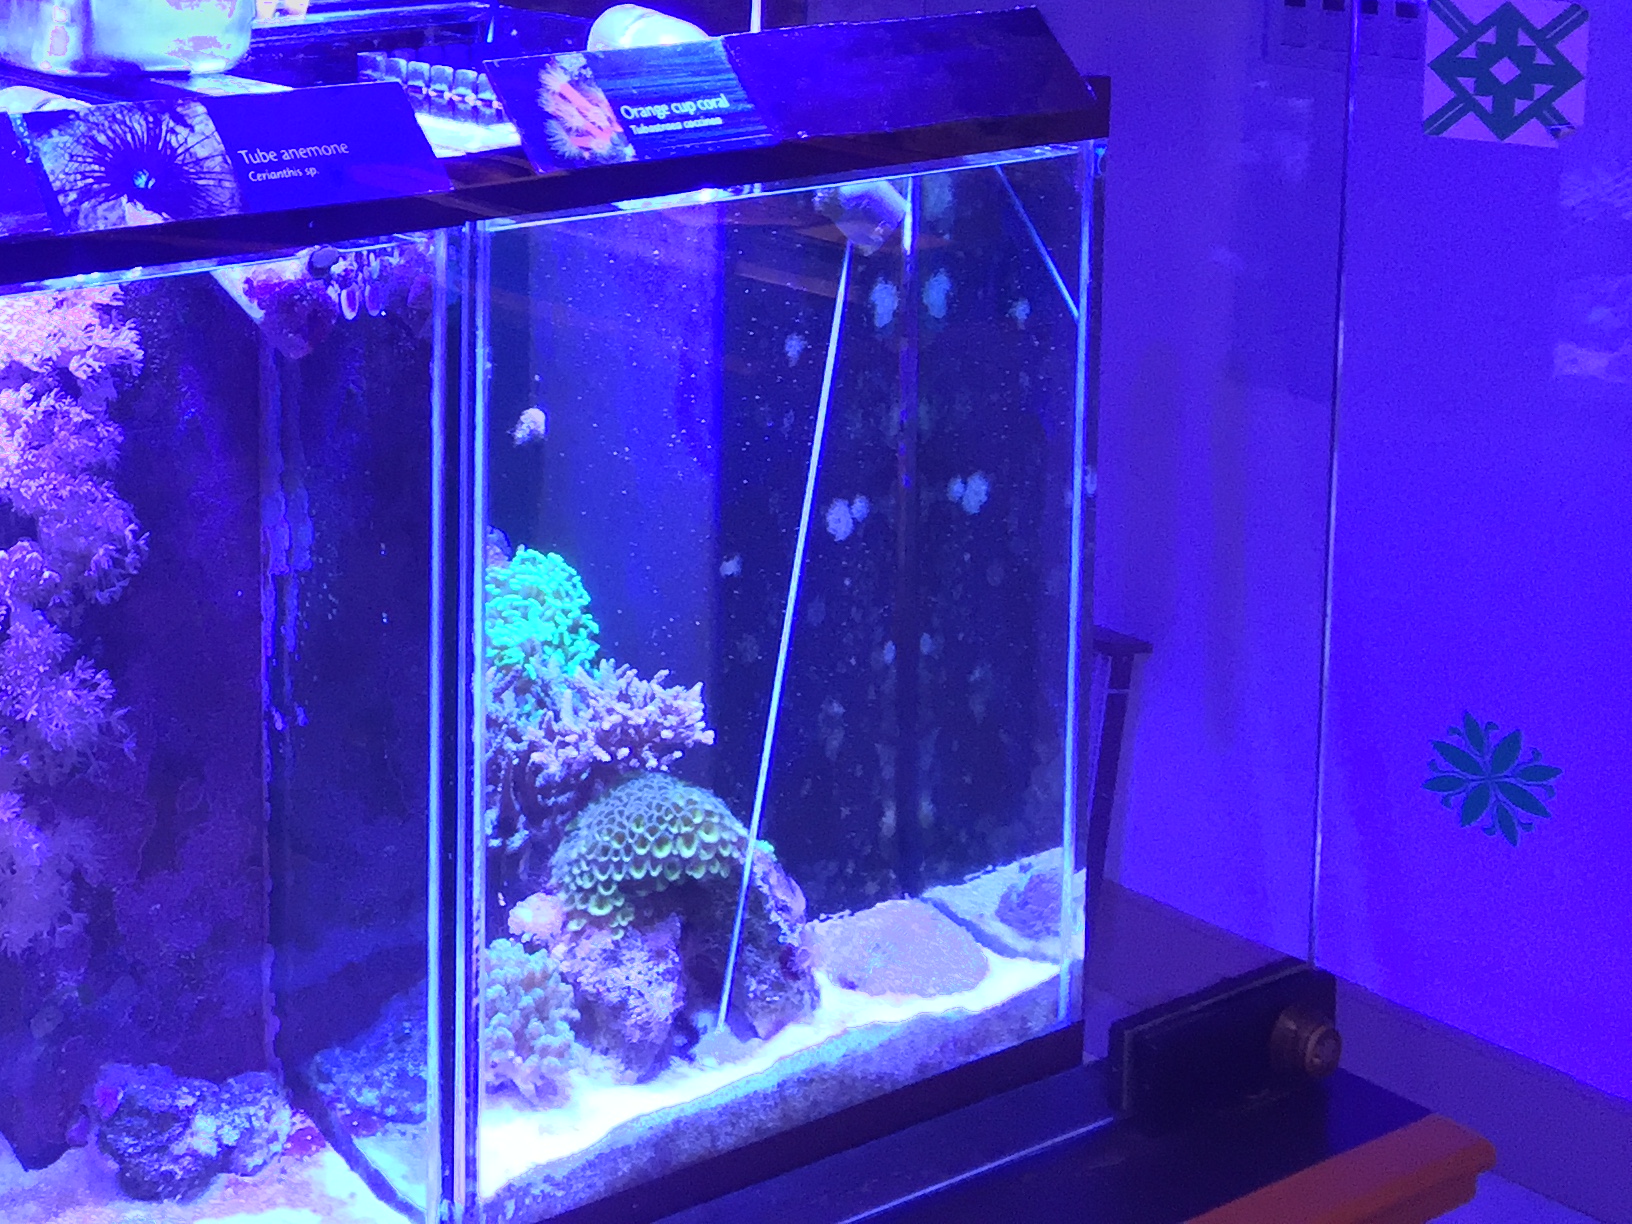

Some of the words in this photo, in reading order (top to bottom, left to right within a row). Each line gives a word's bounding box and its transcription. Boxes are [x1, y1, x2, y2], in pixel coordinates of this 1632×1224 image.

[620, 104, 670, 119] Orange
[670, 101, 696, 115] cup
[696, 93, 730, 110] coral
[237, 148, 278, 164] Tube
[280, 143, 349, 161] anemone
[248, 166, 303, 182] Cerianthis
[304, 166, 320, 177] sp.
